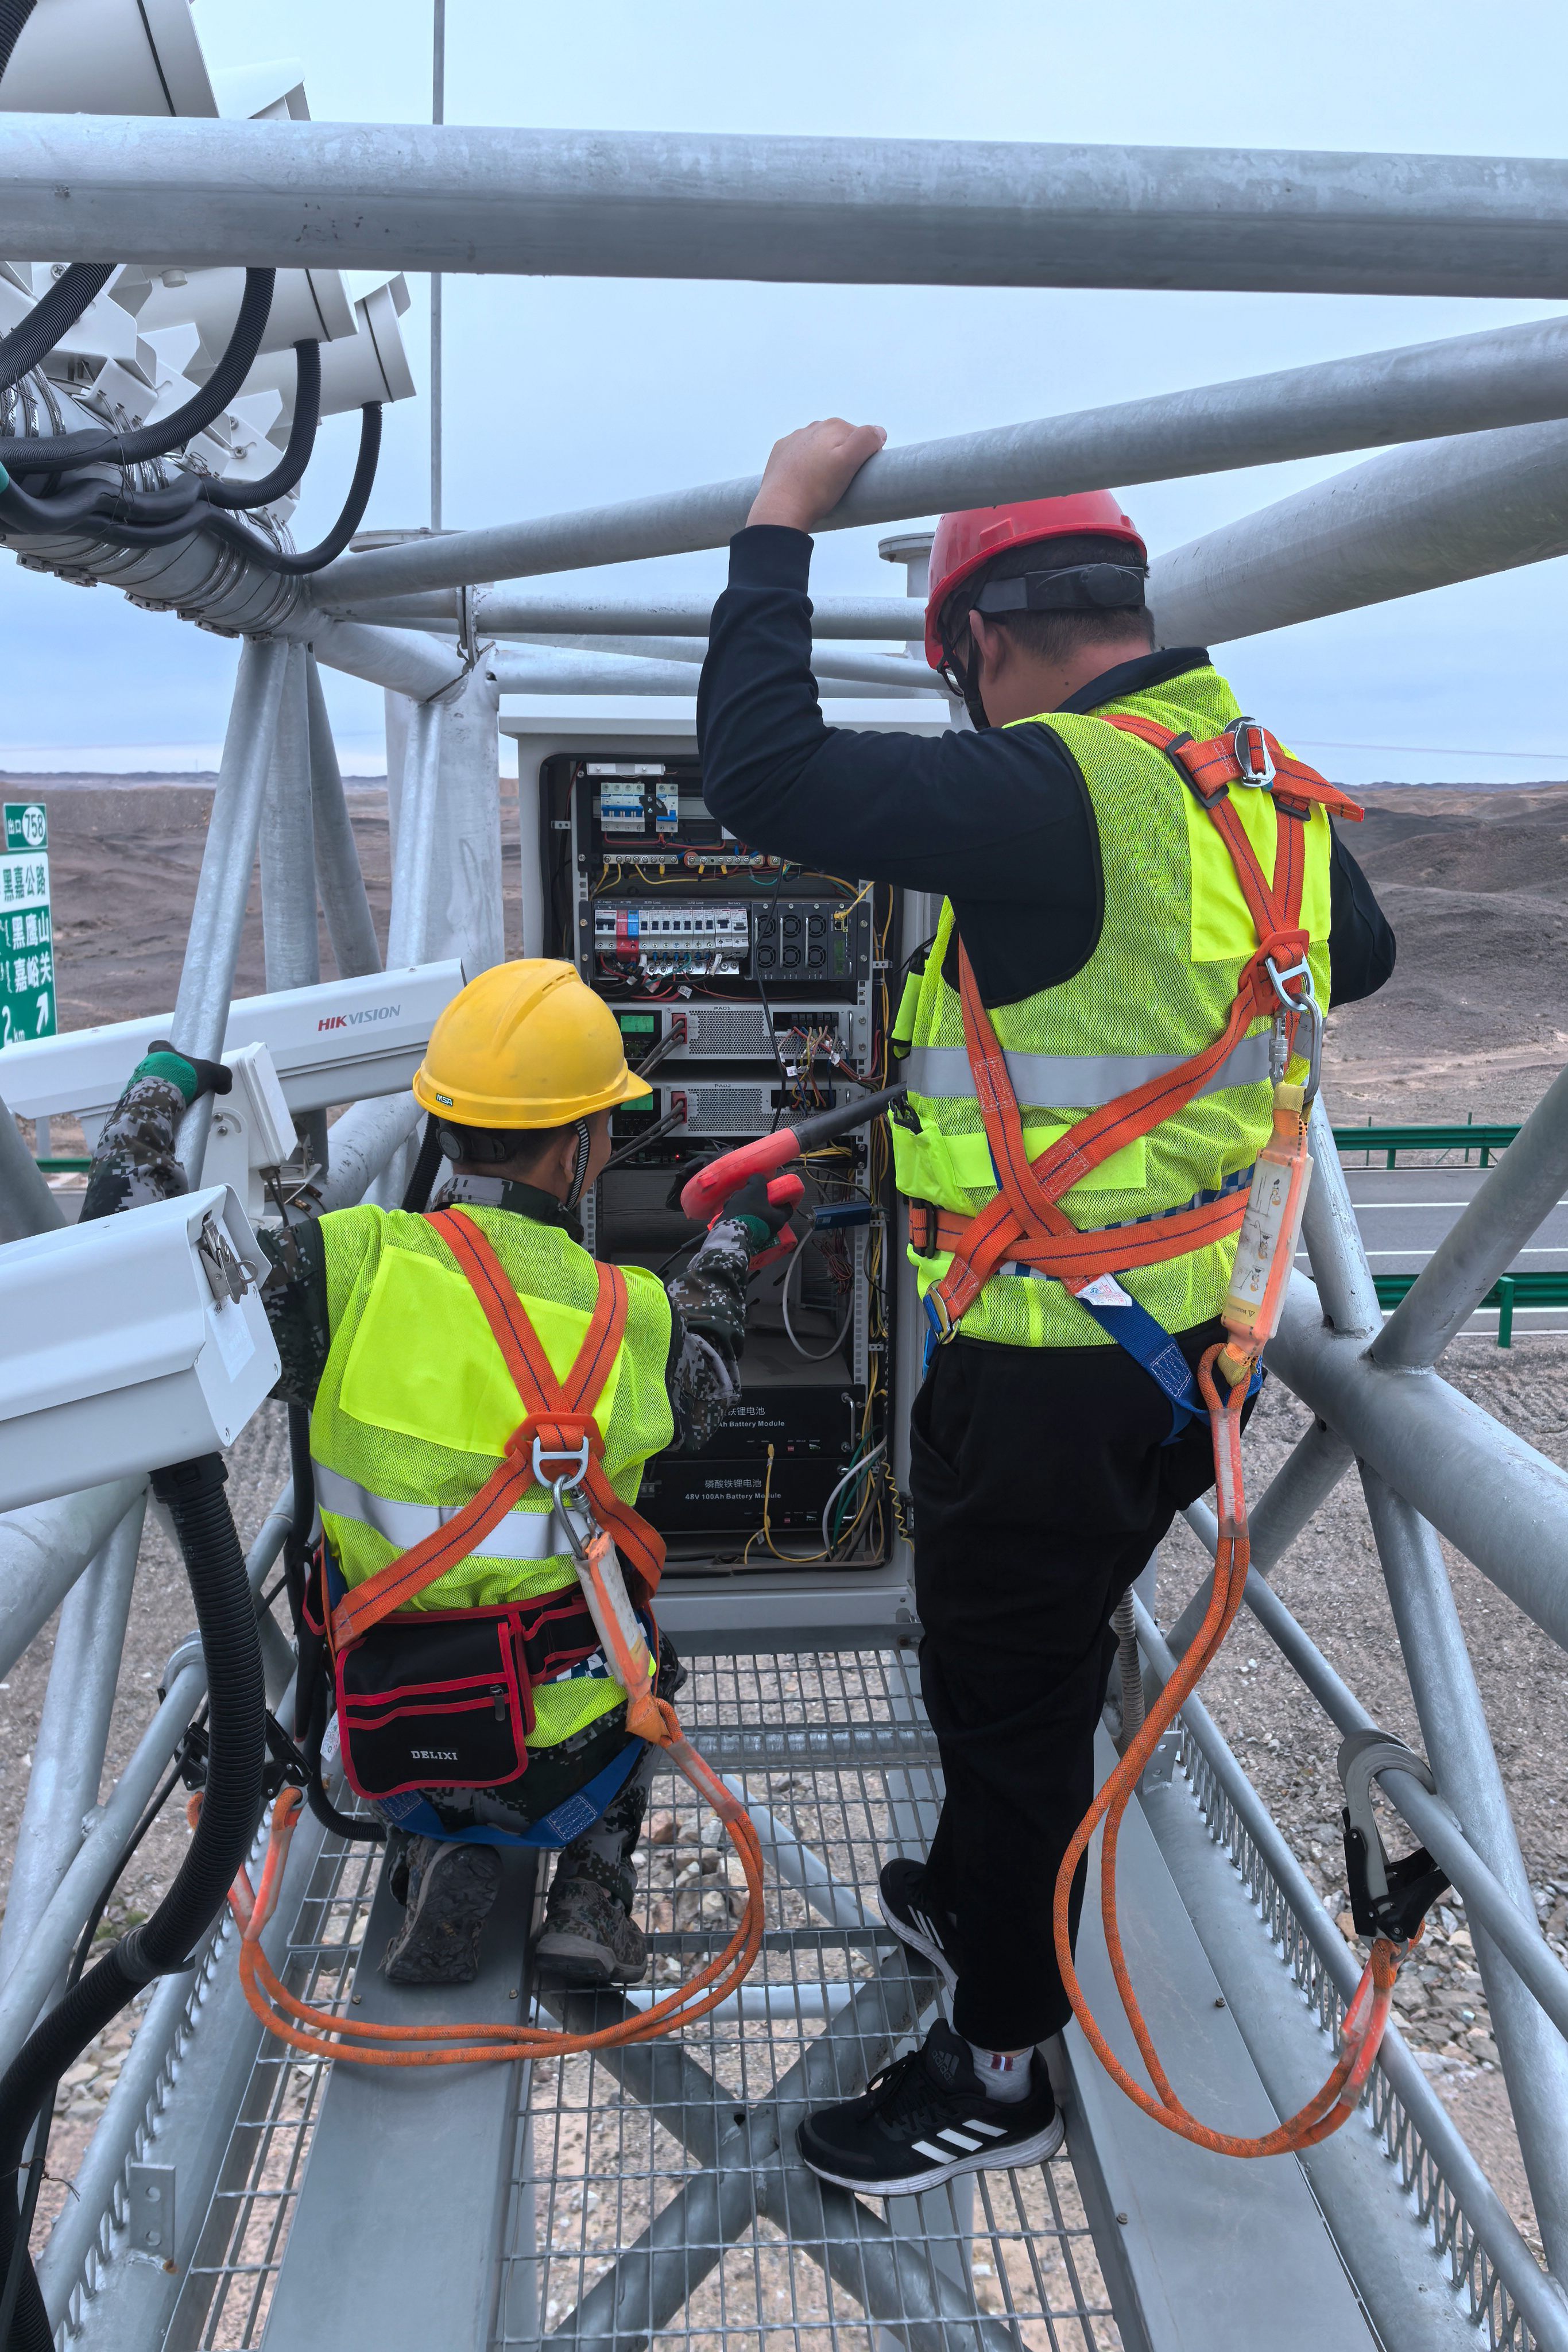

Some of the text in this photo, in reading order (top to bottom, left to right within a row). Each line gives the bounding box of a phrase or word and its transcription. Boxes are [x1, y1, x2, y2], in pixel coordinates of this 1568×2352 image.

[8, 814, 43, 838] 出口 758
[3, 864, 45, 902] 黑嘉公路
[12, 911, 49, 950] 黑鹰山
[14, 950, 52, 993] 嘉峪关
[2, 1005, 25, 1046] 2 km
[318, 1004, 401, 1031] HIKVISION
[437, 1094, 452, 1106] MSA
[725, 1407, 765, 1416] 铁锂电池
[704, 1479, 762, 1488] 磷酸铁锂电池
[411, 1751, 458, 1760] DELIXI
[932, 2050, 955, 2086] adidas
